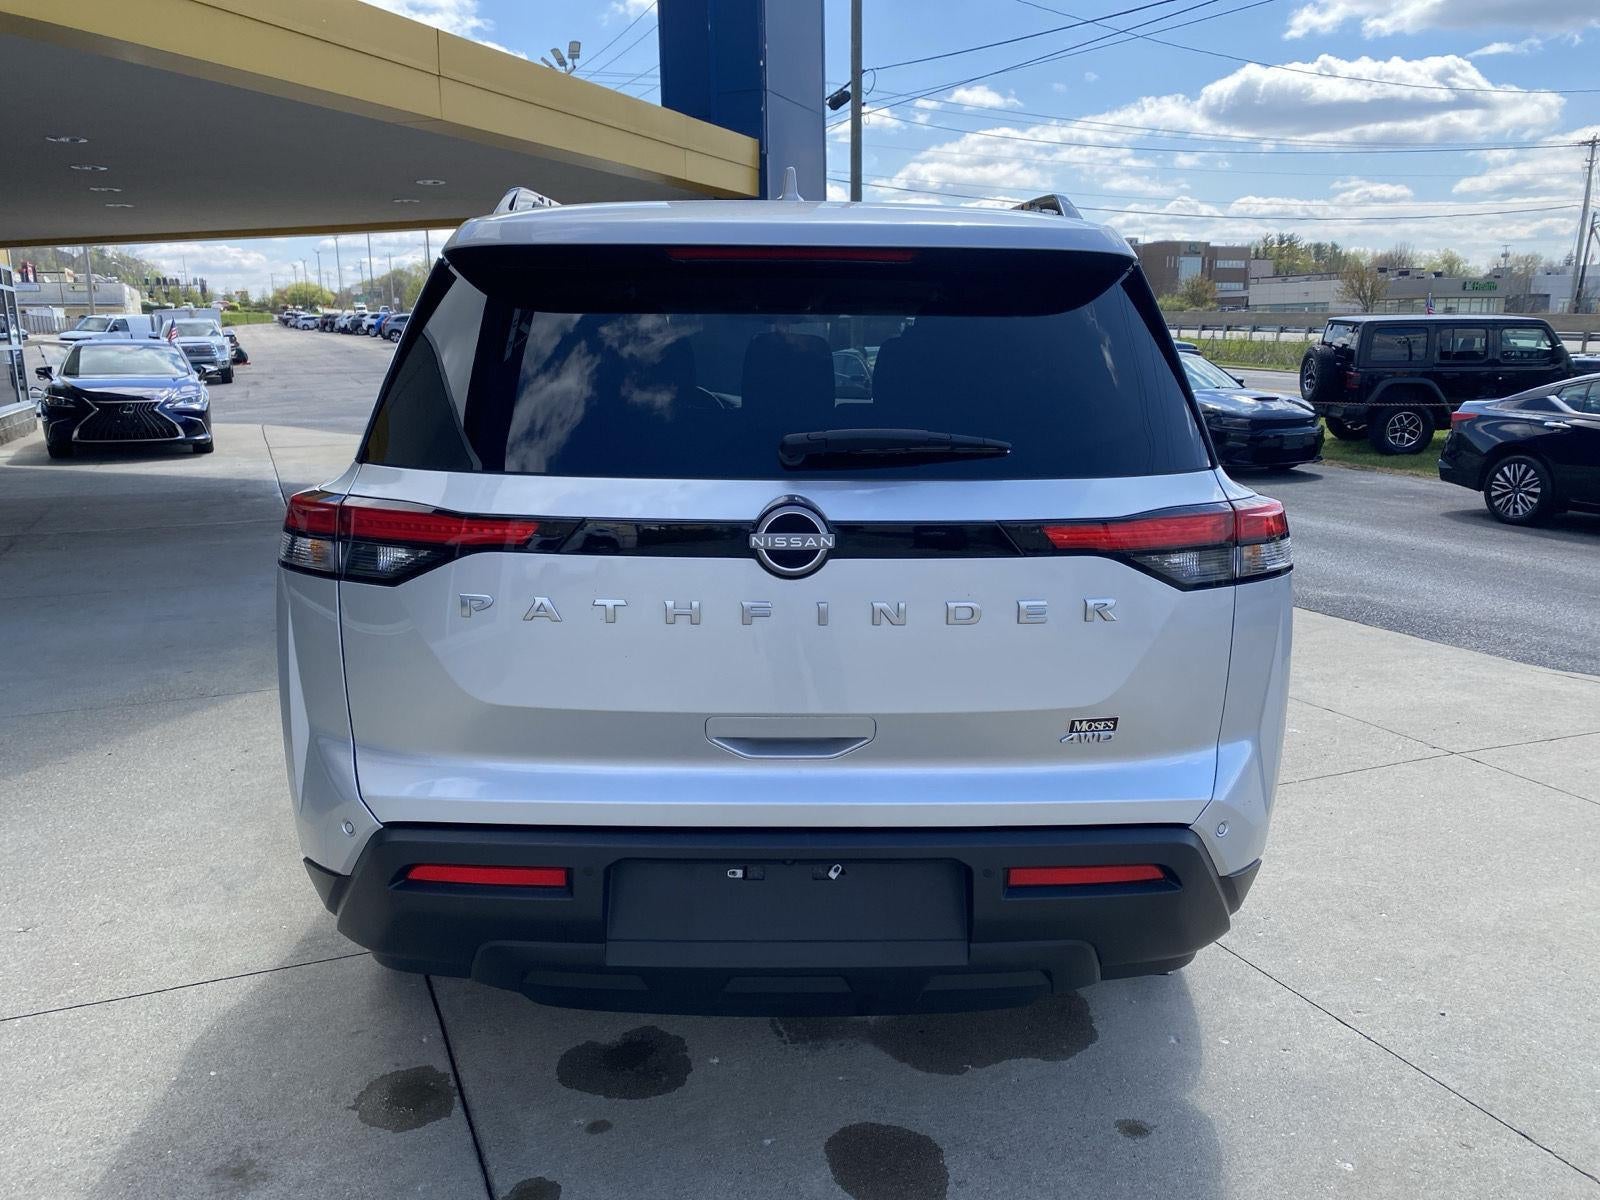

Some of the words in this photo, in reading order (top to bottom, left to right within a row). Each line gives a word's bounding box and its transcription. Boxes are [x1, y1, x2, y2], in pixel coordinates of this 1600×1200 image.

[751, 536, 833, 548] NISSAN
[459, 592, 1119, 626] PATHFINDER
[1073, 720, 1114, 732] MOSES
